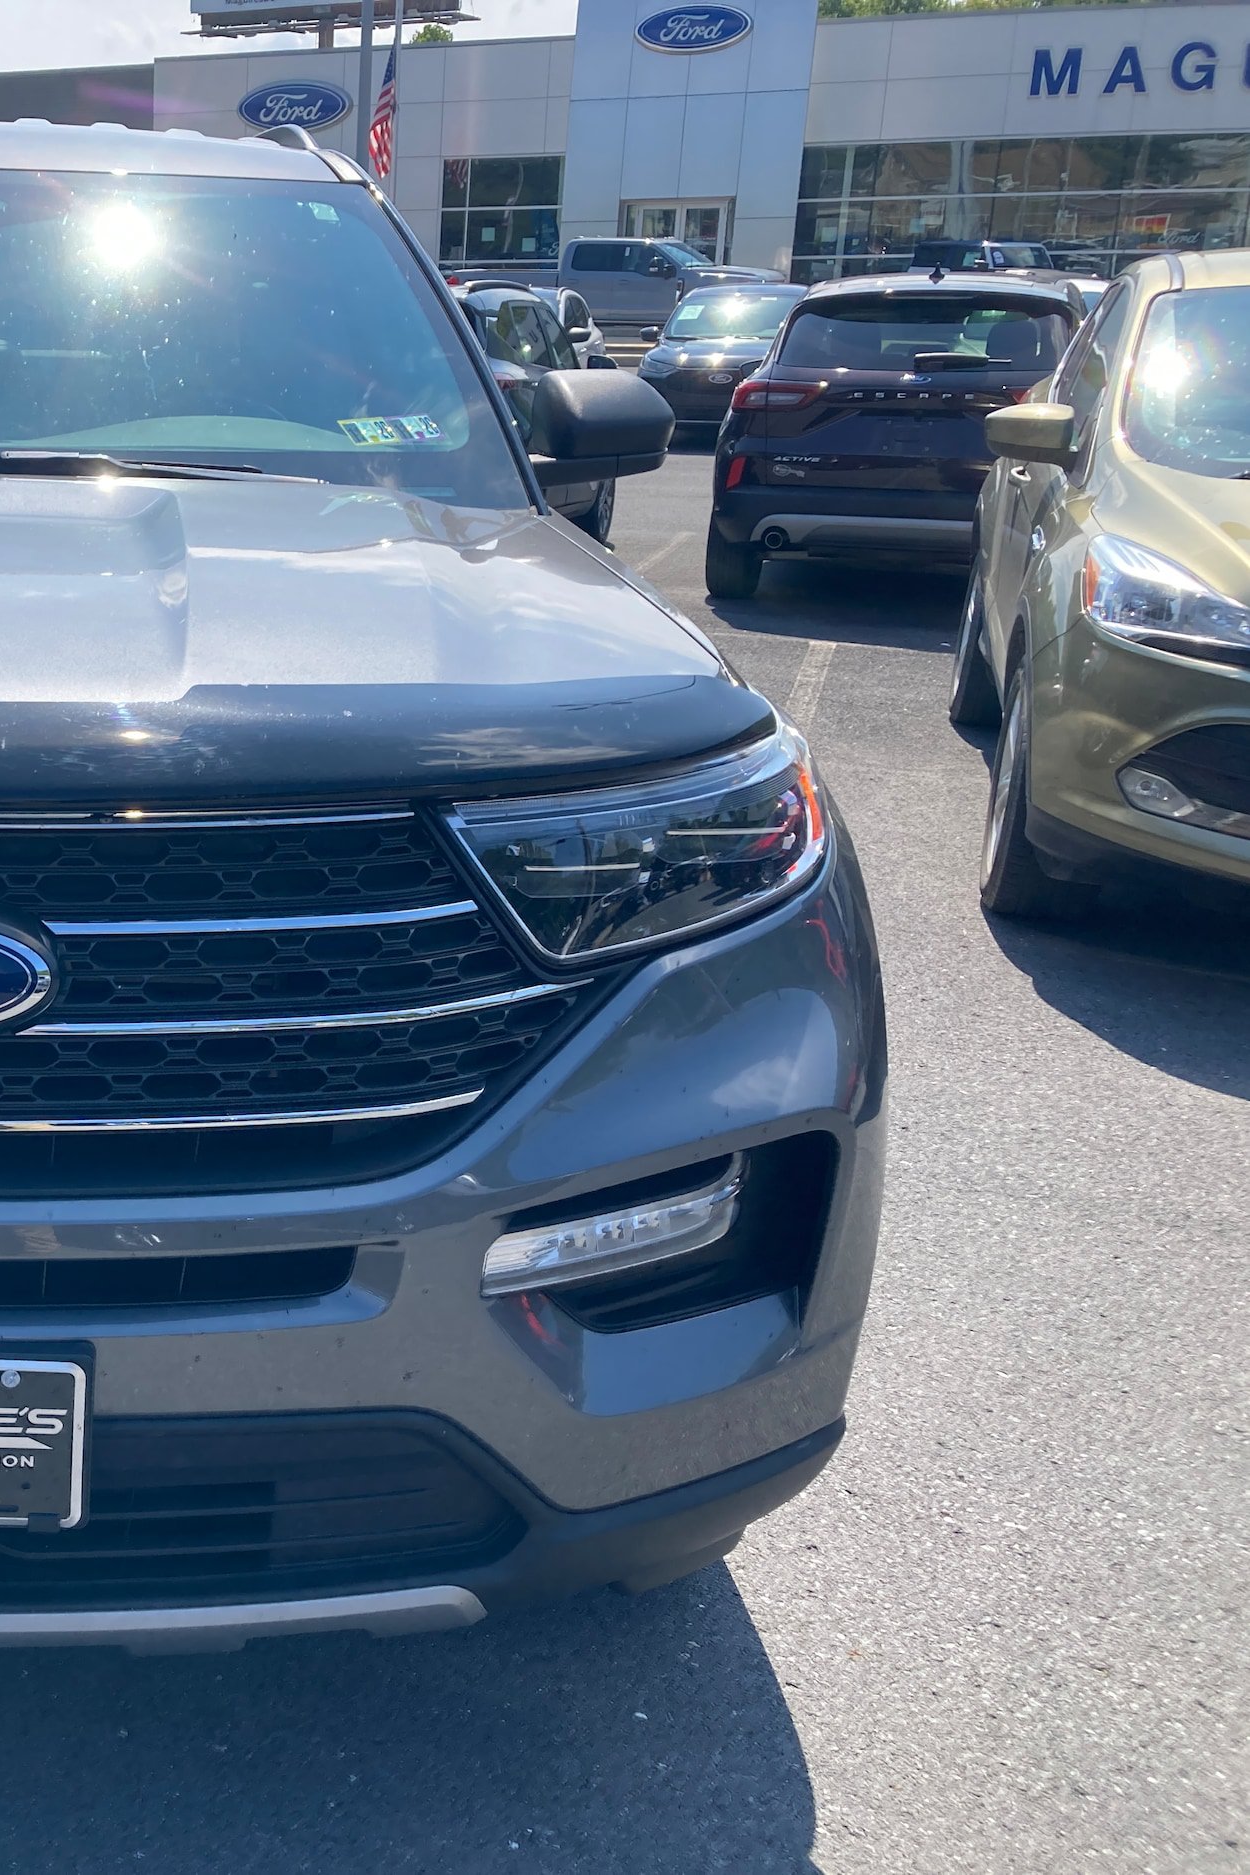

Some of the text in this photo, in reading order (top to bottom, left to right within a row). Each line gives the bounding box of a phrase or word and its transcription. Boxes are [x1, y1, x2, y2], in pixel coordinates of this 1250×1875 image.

[659, 14, 725, 42] Ford
[1029, 41, 1250, 96] MAG
[259, 93, 323, 122] Ford
[853, 391, 975, 400] ESCAPE
[773, 455, 821, 463] ACTIVE
